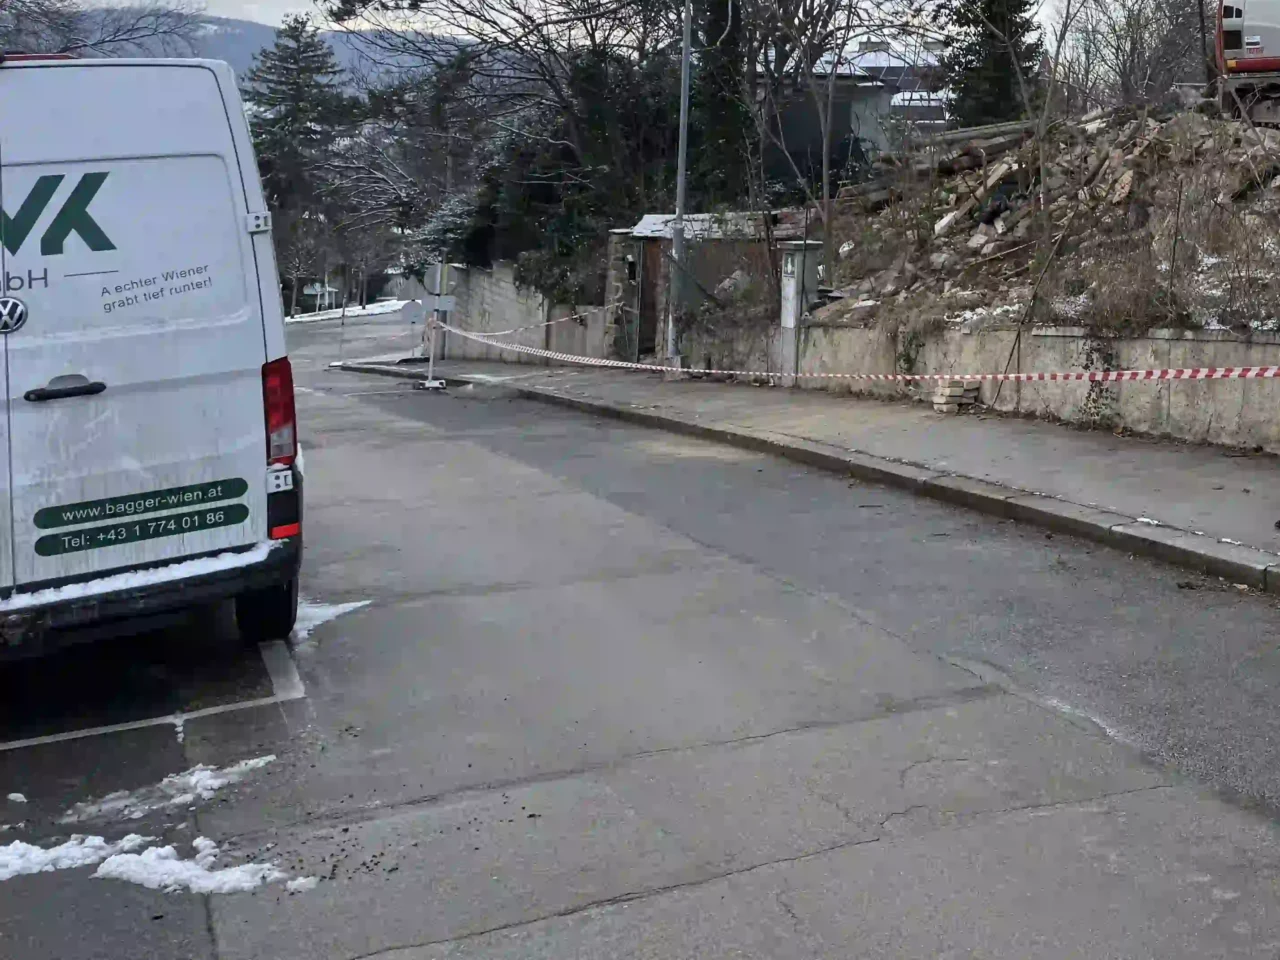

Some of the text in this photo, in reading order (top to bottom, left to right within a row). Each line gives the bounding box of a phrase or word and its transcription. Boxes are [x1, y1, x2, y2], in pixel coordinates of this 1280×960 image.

[0, 267, 49, 292] bH
[101, 264, 209, 297] A echter Wiener
[103, 276, 213, 314] grabt tief runter!
[62, 485, 223, 521] www.bagger-wien.at
[61, 510, 225, 549] Tel: +43 1 774 01 86
